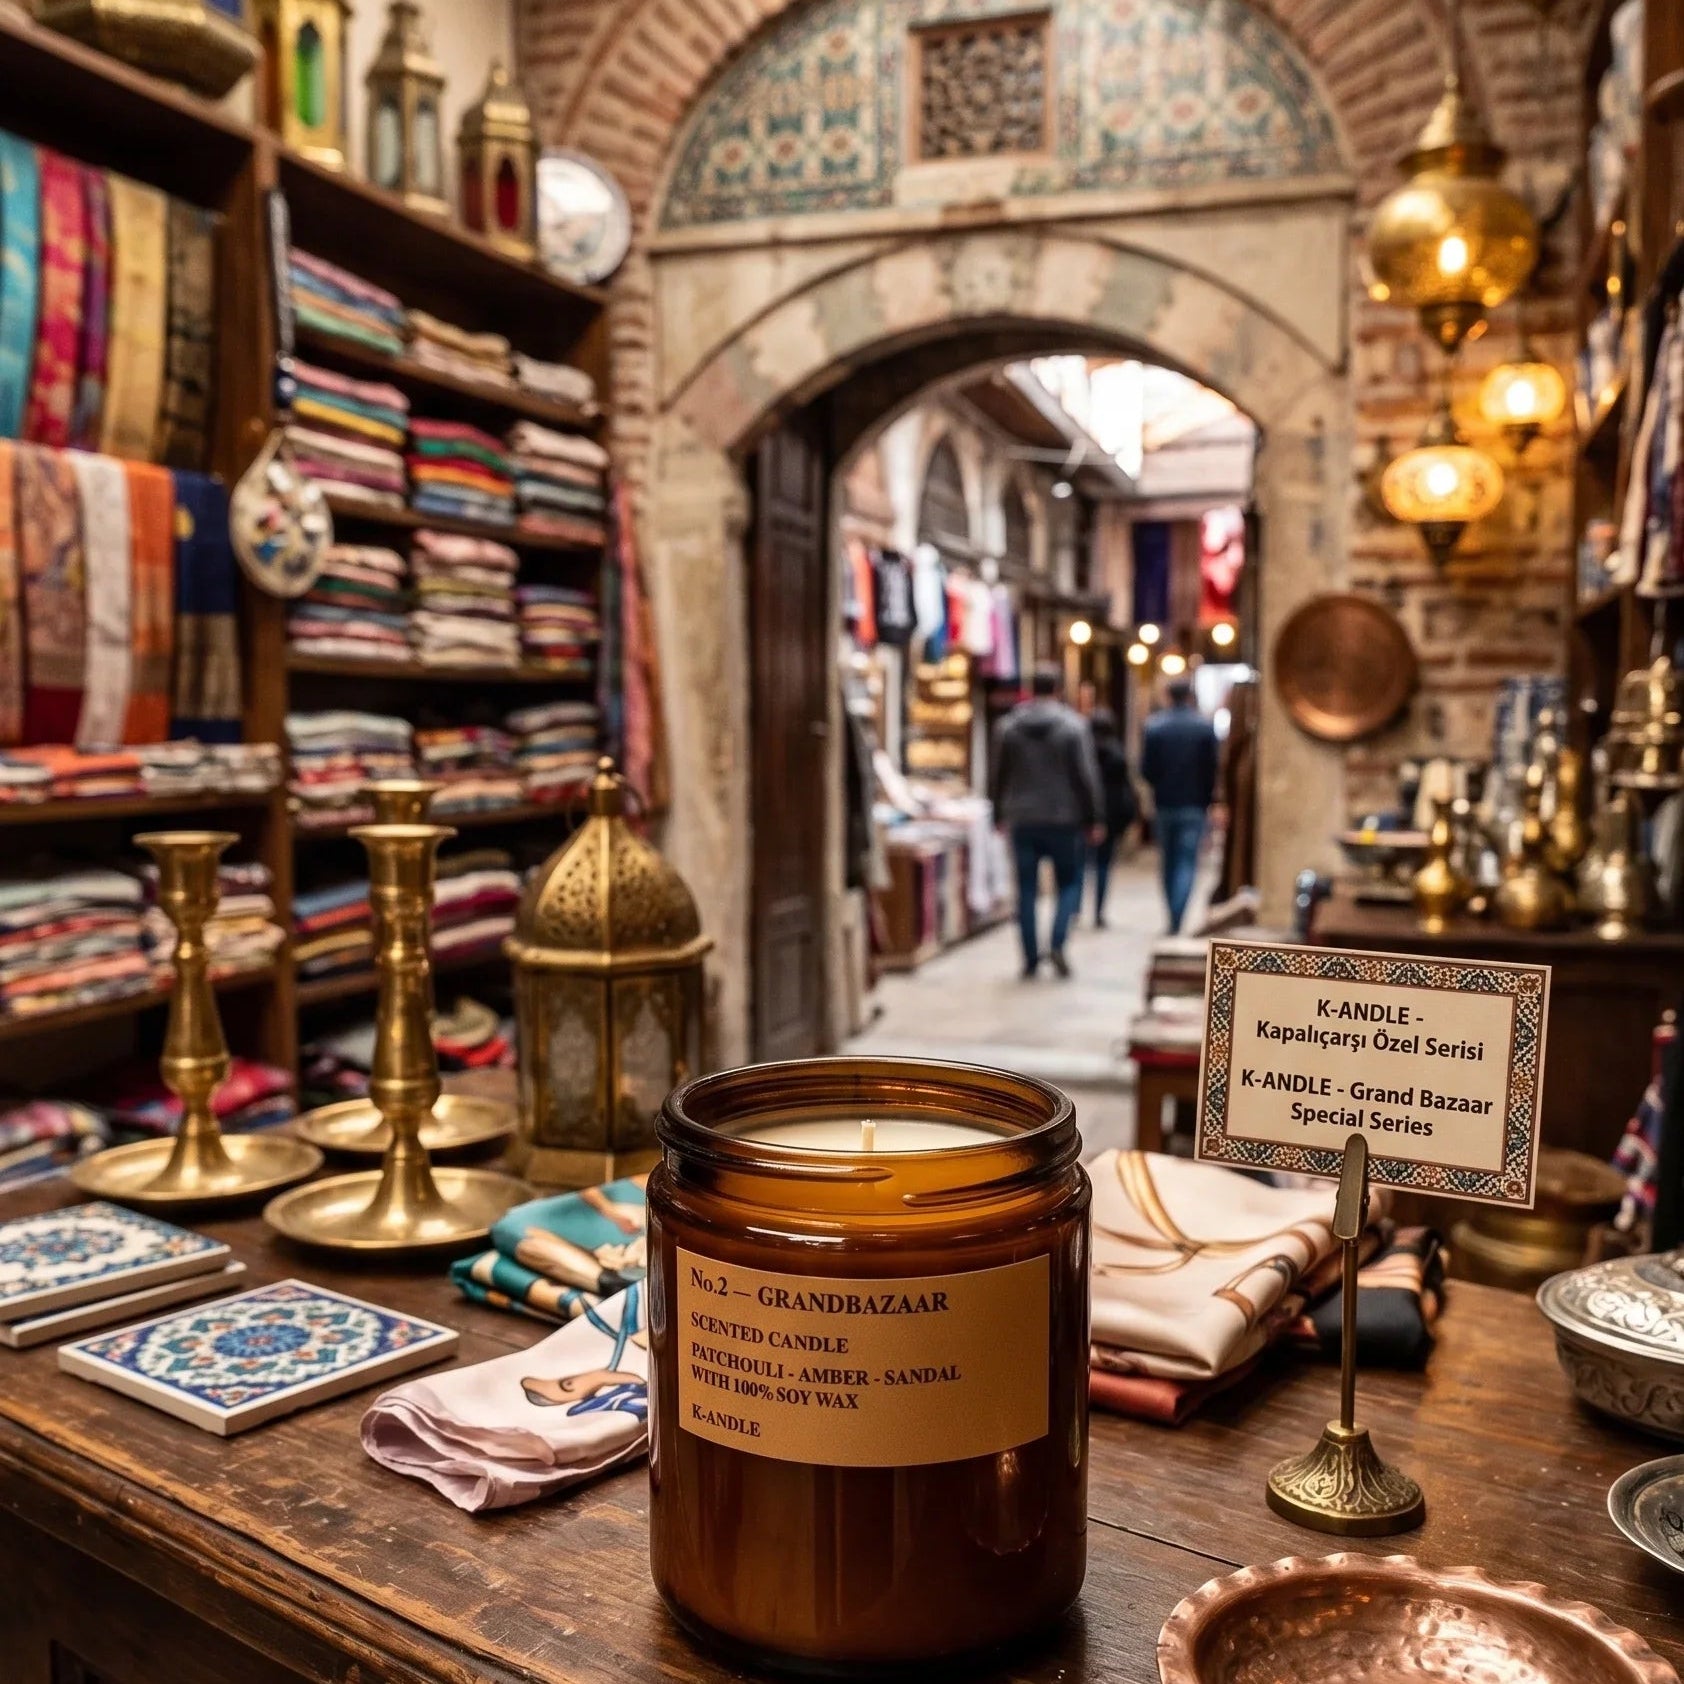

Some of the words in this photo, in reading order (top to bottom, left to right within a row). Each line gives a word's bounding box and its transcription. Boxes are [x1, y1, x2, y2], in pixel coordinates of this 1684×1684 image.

[1318, 999, 1409, 1025] K-ANDLE
[1256, 1020, 1367, 1053] Kapalıçarşı
[1373, 1029, 1419, 1054] Özel
[1425, 1038, 1483, 1060] Serisi
[1242, 1069, 1331, 1096] K-ANDLE
[1350, 1082, 1413, 1106] Grand
[1420, 1090, 1493, 1114] Bazaar
[1291, 1103, 1363, 1127] Special
[1370, 1112, 1432, 1136] Series
[691, 1267, 728, 1296] No.2
[758, 1287, 950, 1314] GRANDBAZAAR
[691, 1311, 764, 1344] SCENTED
[769, 1332, 848, 1353] CANDLE
[691, 1341, 784, 1379] PATCHOULI
[799, 1368, 869, 1385] AMBER
[885, 1365, 961, 1385] SANDAL
[691, 1364, 730, 1390] WITH
[734, 1379, 773, 1400] 100%
[777, 1387, 811, 1405] SOY
[815, 1392, 858, 1409] WAX
[692, 1404, 761, 1438] K-ANDLE
